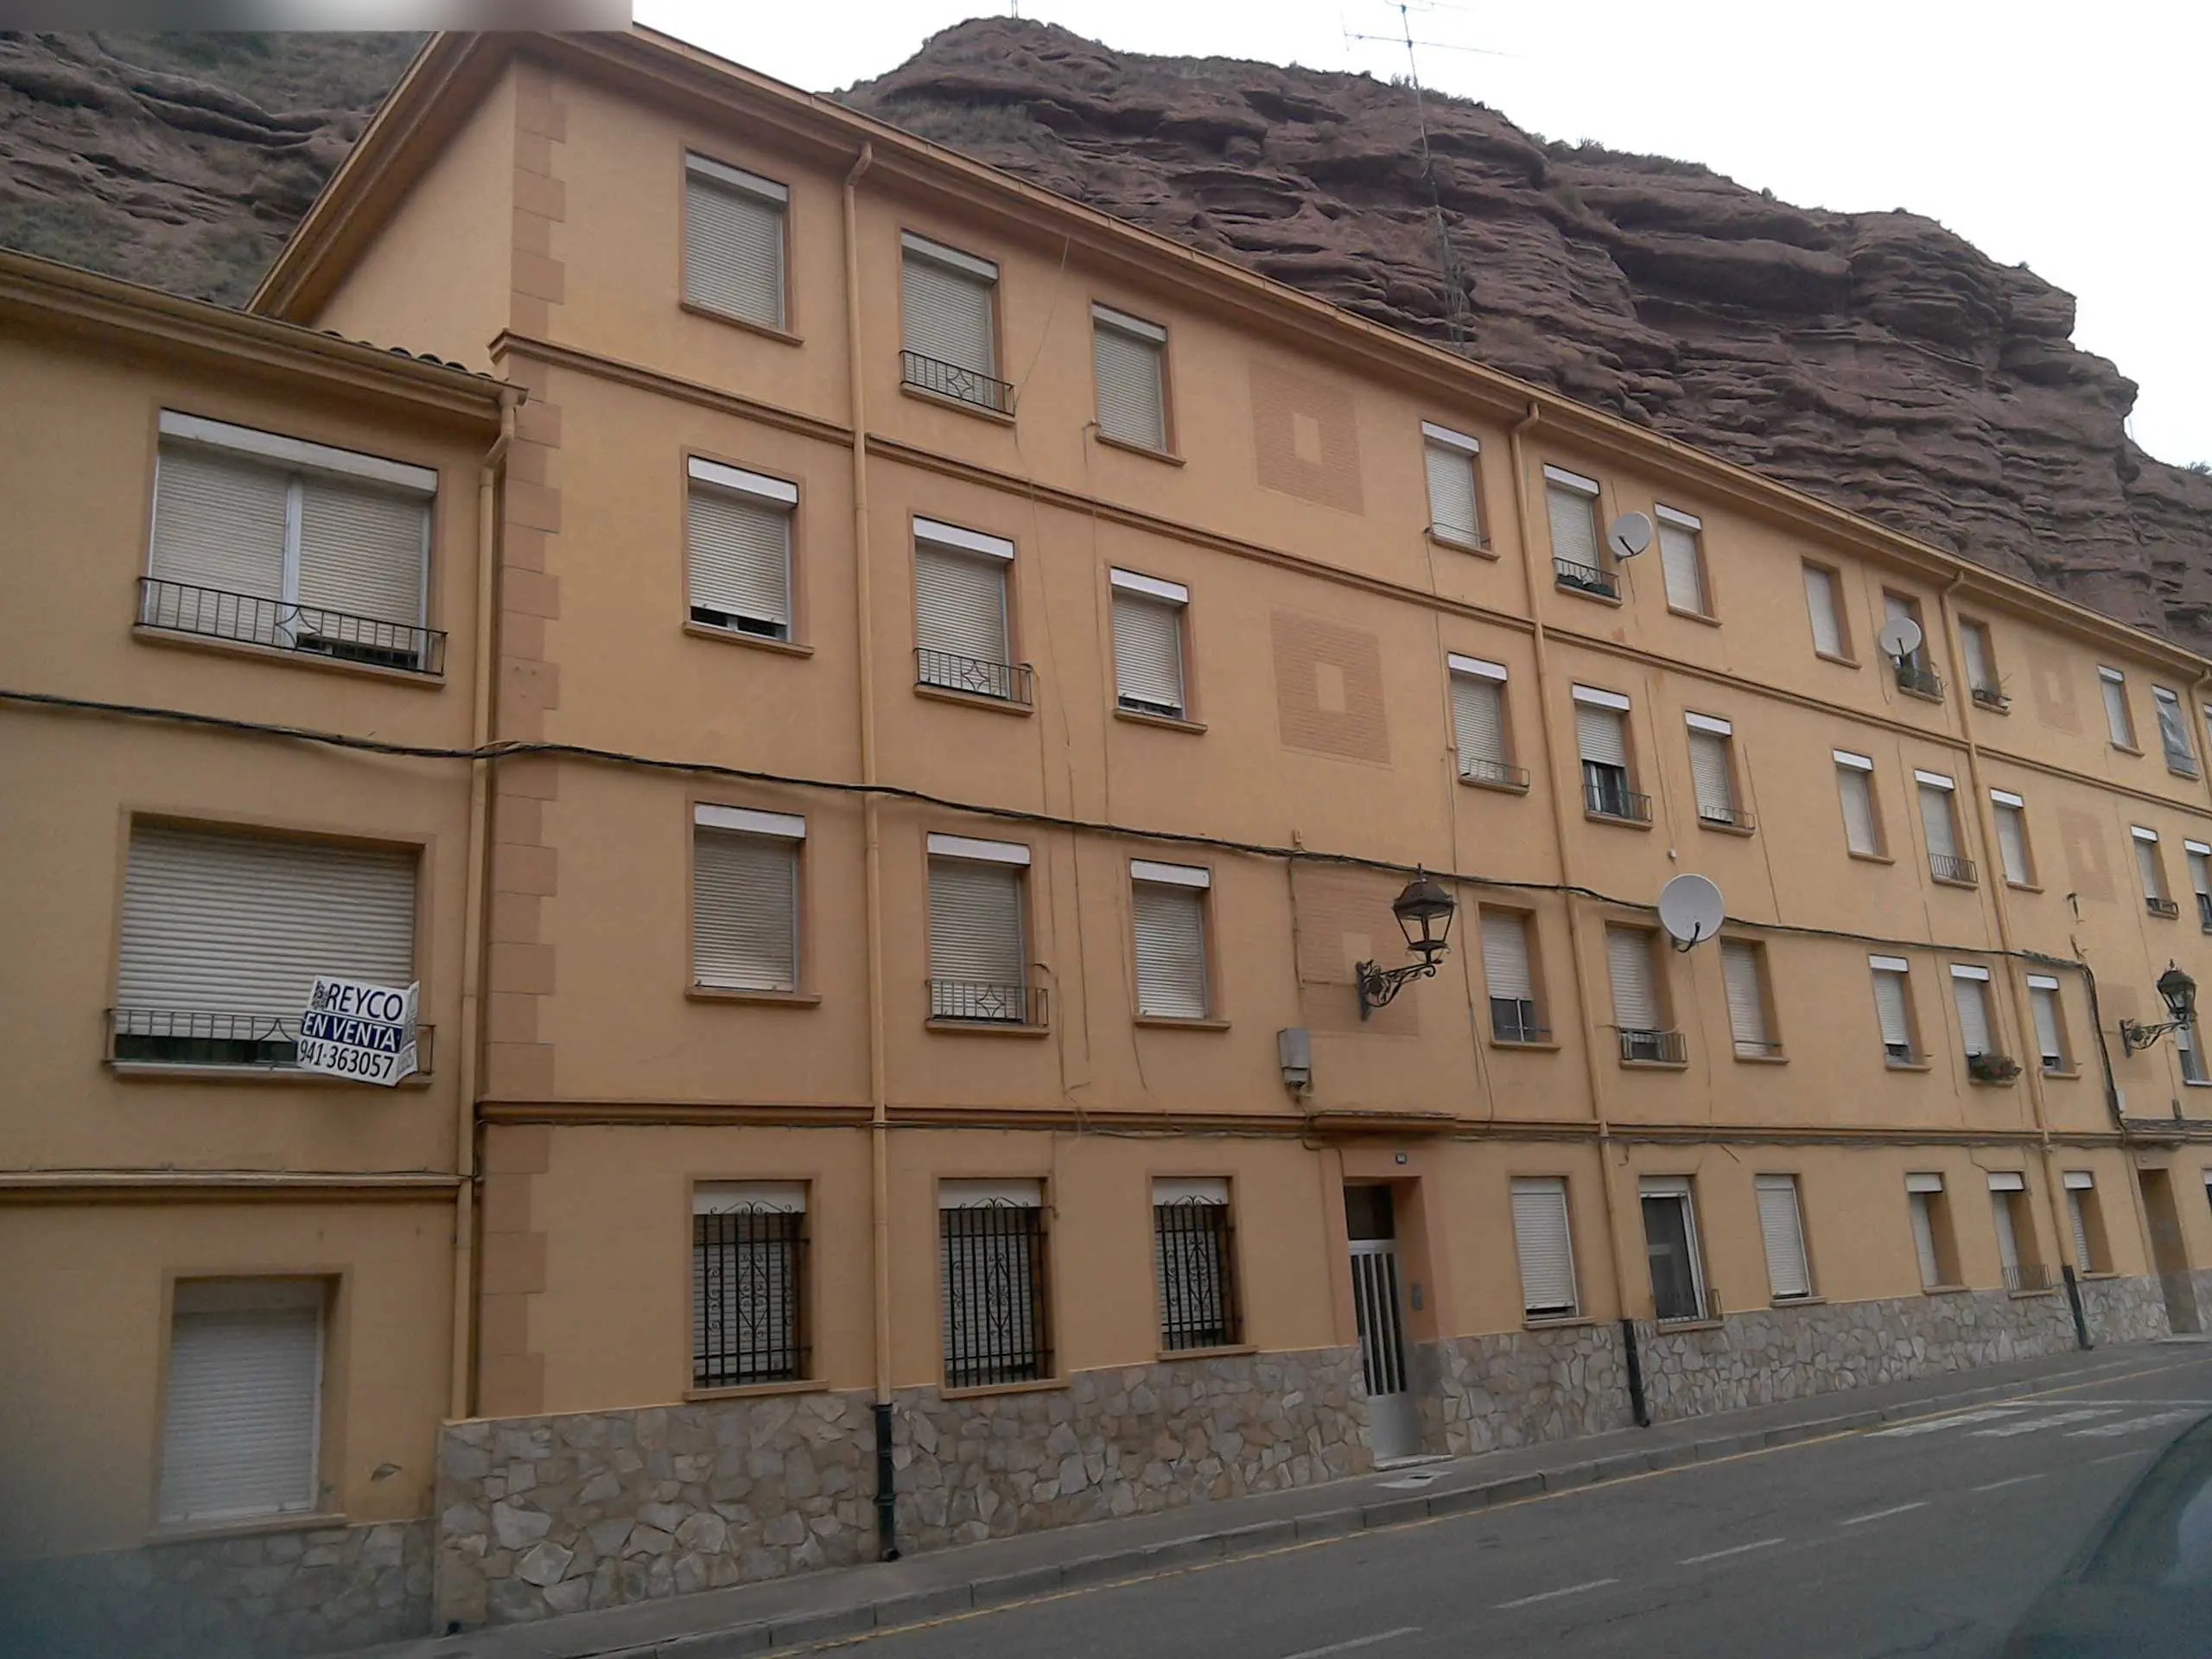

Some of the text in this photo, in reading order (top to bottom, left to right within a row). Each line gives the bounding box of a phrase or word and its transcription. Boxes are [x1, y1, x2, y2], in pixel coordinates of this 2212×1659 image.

[326, 983, 403, 1021] REYCO
[302, 1013, 397, 1052] EN VENTA
